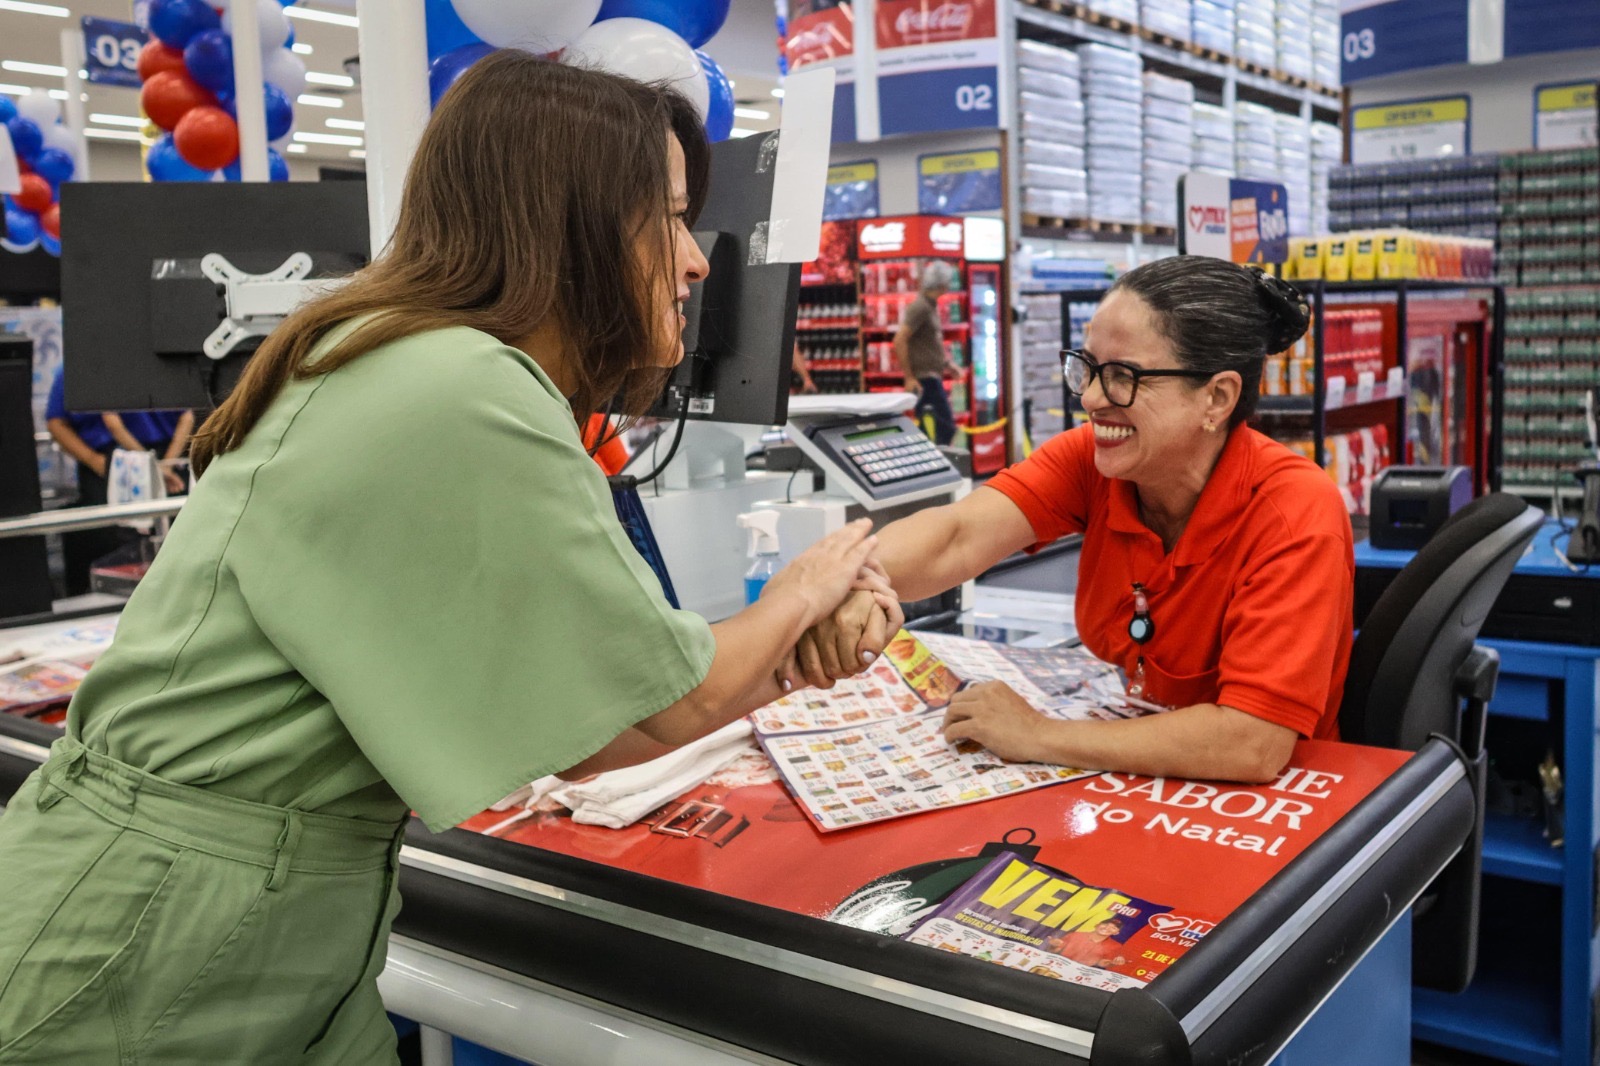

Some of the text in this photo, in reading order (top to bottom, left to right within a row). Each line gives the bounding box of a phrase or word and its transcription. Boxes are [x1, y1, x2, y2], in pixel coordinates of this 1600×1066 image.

[96, 35, 142, 71] 03
[1344, 29, 1375, 62] 03
[955, 85, 993, 111] 02
[1384, 109, 1434, 123] OFERTA
[1084, 771, 1314, 831] SABOR
[1073, 801, 1287, 857] do Natal
[978, 858, 1131, 934] VEM
[1110, 903, 1137, 917] PRO
[954, 912, 986, 929] OFERTAS
[984, 923, 996, 932] DE
[993, 928, 1044, 946] INAUGURAÇÃO
[1150, 932, 1176, 944] BOA
[1141, 950, 1156, 960] 21
[1155, 954, 1170, 963] DE
